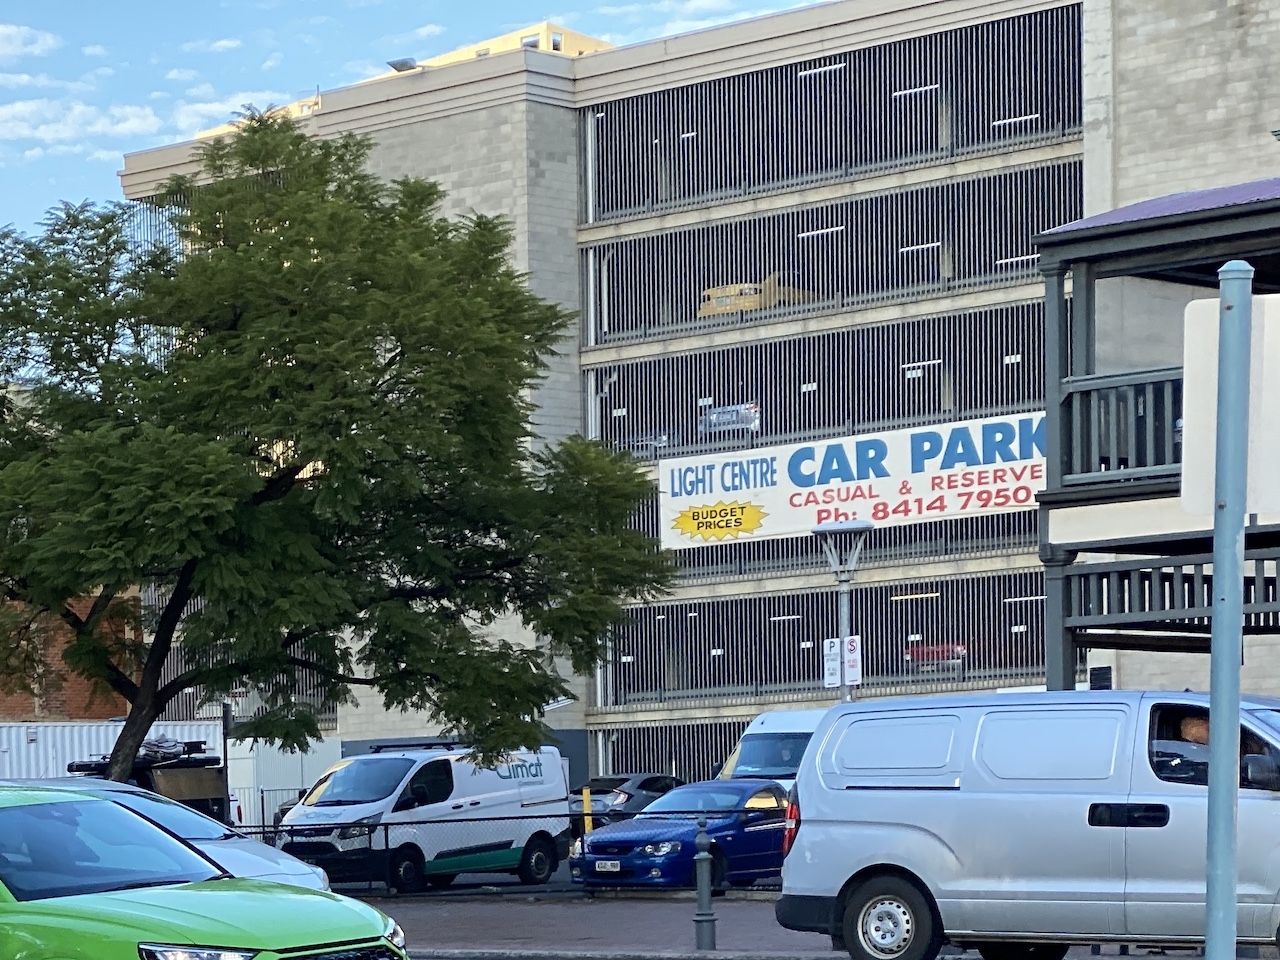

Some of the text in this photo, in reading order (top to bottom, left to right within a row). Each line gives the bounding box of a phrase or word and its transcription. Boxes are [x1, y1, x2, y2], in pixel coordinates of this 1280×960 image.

[787, 417, 1047, 488] CAR PARK
[670, 456, 778, 498] LIGHT CENTRE
[789, 463, 1043, 508] CASUAL & RESERVE
[692, 506, 747, 521] BUDGET
[696, 518, 743, 531] PRICES
[816, 485, 1032, 526] Ph: 8414 7950
